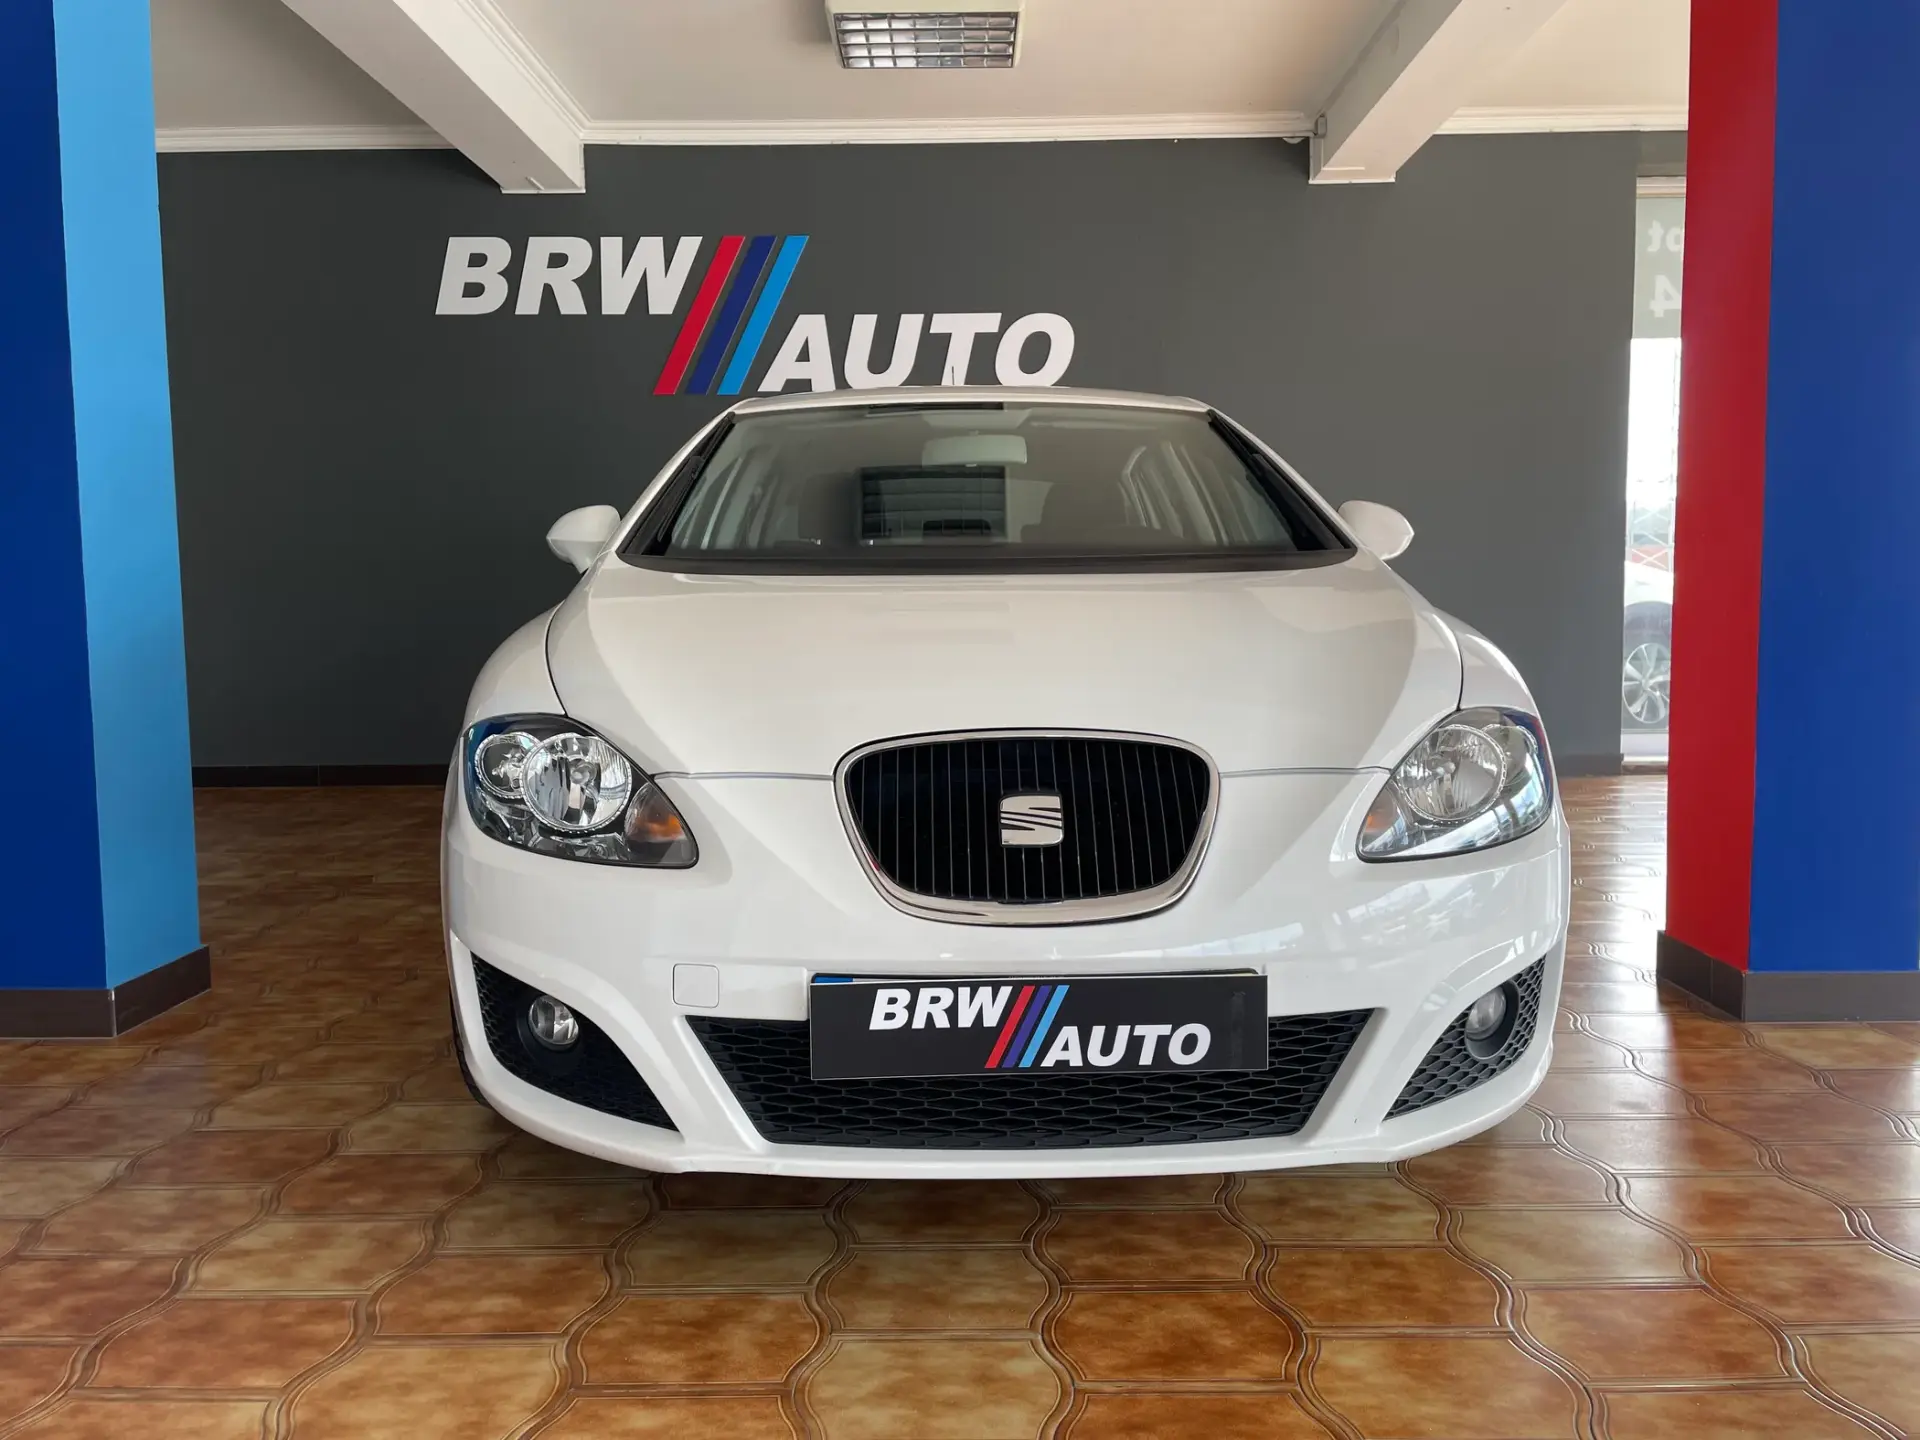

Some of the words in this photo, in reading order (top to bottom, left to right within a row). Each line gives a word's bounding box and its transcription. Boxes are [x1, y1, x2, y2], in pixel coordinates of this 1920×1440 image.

[435, 236, 703, 316] BRW
[758, 312, 1075, 393] AUTO
[868, 985, 1013, 1031] BRW
[1039, 1022, 1212, 1068] AUTO
